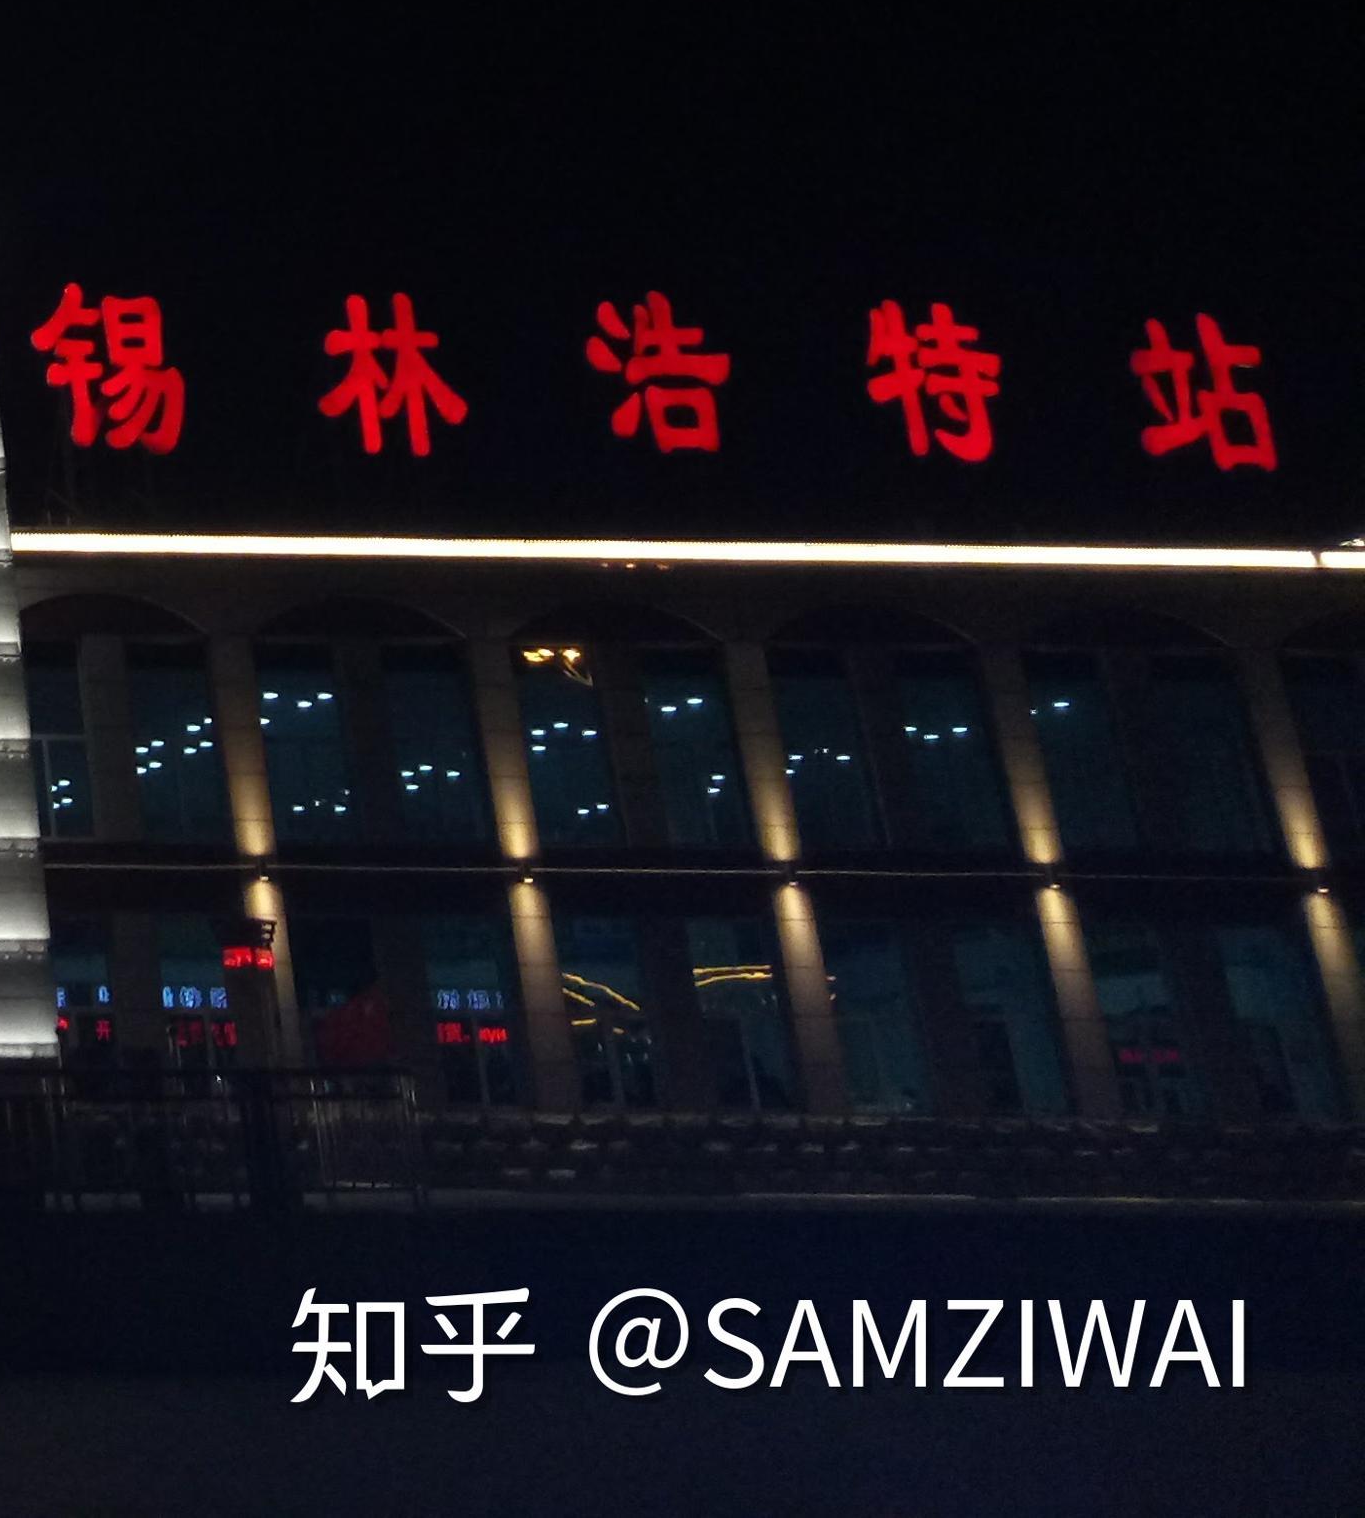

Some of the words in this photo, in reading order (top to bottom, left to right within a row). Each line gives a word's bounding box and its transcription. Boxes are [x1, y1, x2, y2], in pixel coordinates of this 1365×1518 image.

[30, 282, 1277, 471] 锡林浩特站
